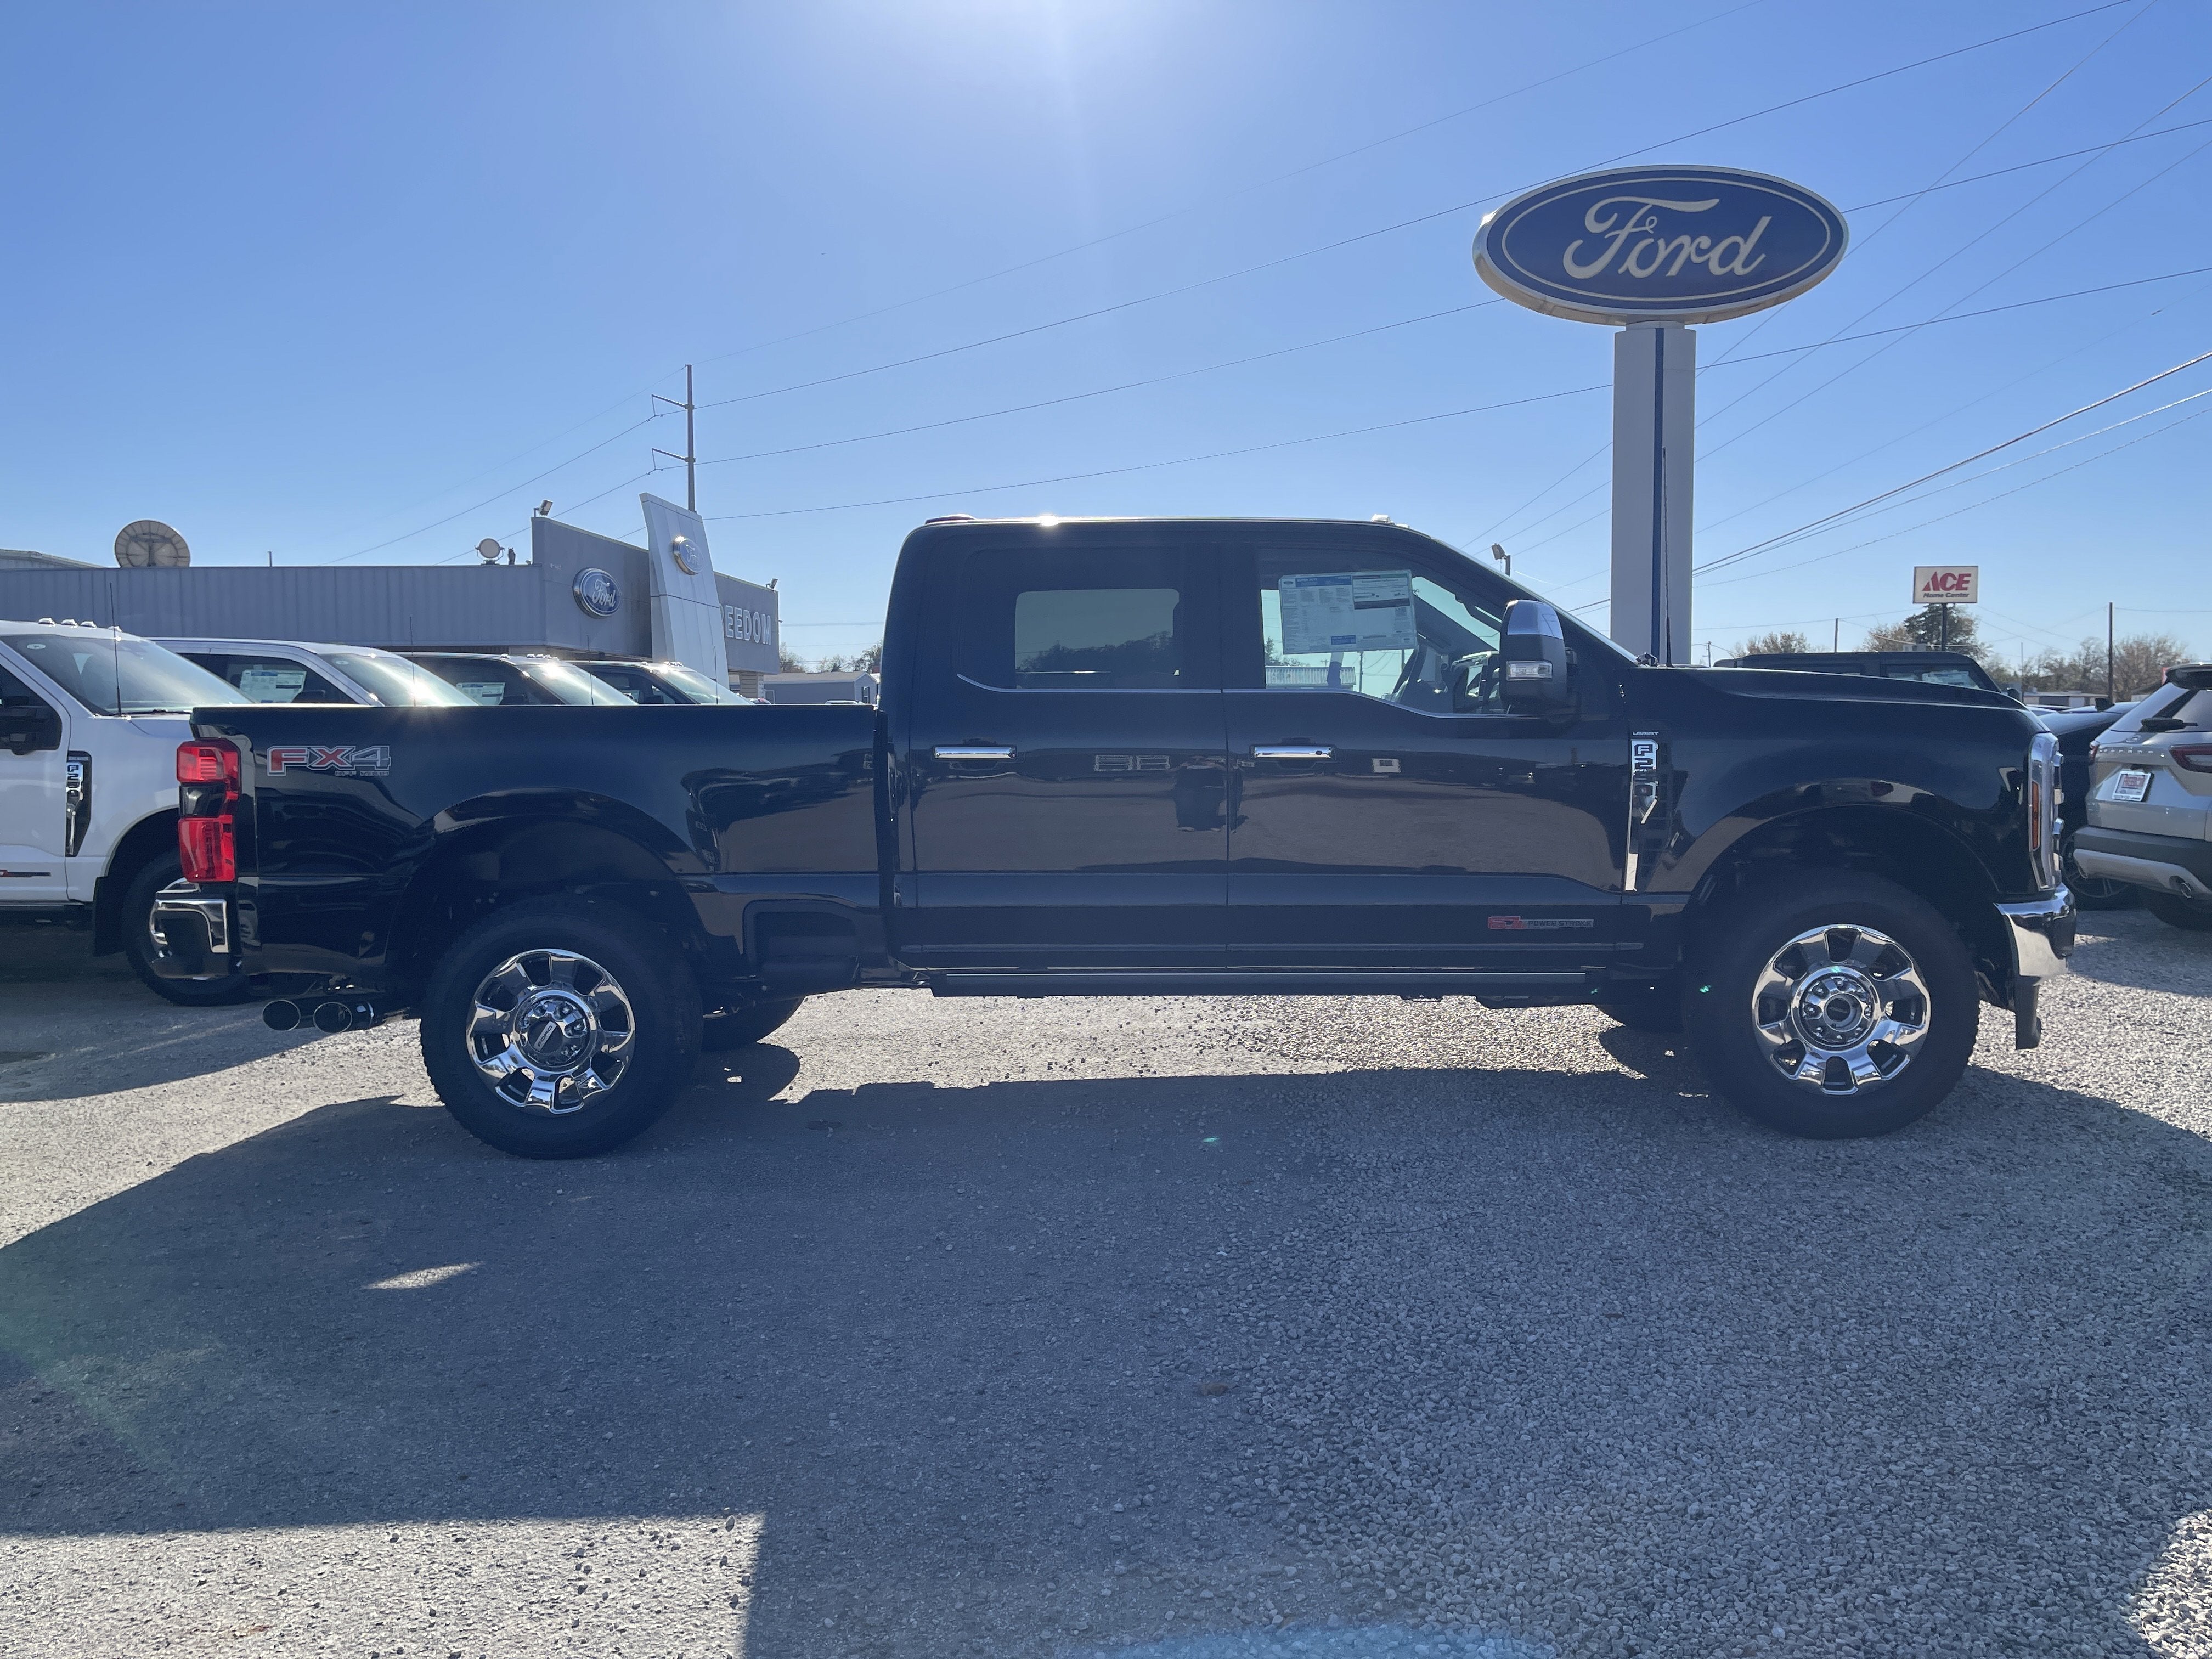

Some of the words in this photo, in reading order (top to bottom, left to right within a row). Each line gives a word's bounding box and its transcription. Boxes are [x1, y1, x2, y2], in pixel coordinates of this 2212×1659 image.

[1562, 196, 1772, 279] Ford
[685, 544, 701, 566] Ford
[592, 579, 616, 607] Ford
[1922, 571, 1972, 591] ACE
[267, 746, 391, 776] FX4
[538, 1025, 552, 1047] FORD
